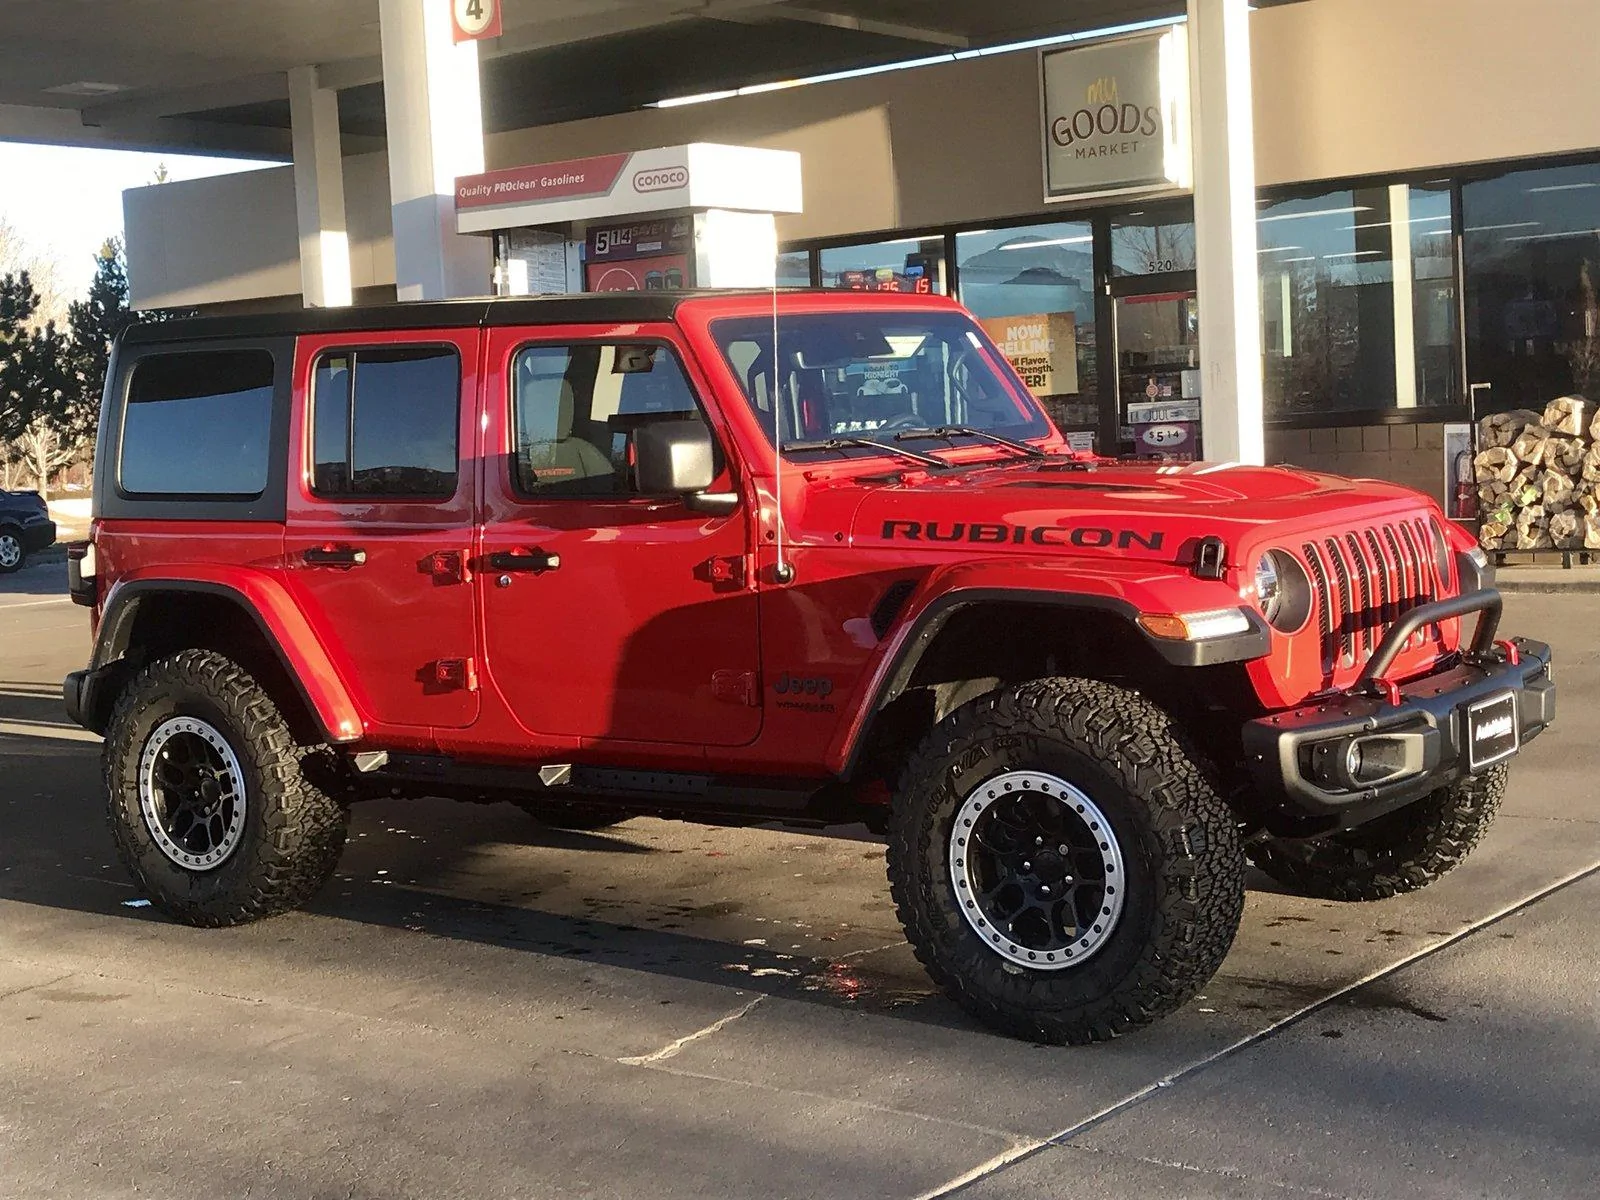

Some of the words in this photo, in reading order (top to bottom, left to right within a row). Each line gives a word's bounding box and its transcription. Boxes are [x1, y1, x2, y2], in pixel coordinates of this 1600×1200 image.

[466, 0, 483, 20] 4
[1051, 103, 1160, 147] GOODS
[1075, 140, 1139, 159] MARKET
[459, 184, 492, 198] Quality
[540, 173, 585, 188] Gasolines
[1149, 260, 1172, 272] 520
[1006, 324, 1043, 341] NOW
[996, 339, 1055, 357] SELLING
[1020, 356, 1048, 366] Flavor.
[881, 519, 1165, 550] RUBICON
[772, 671, 834, 700] Jeep
